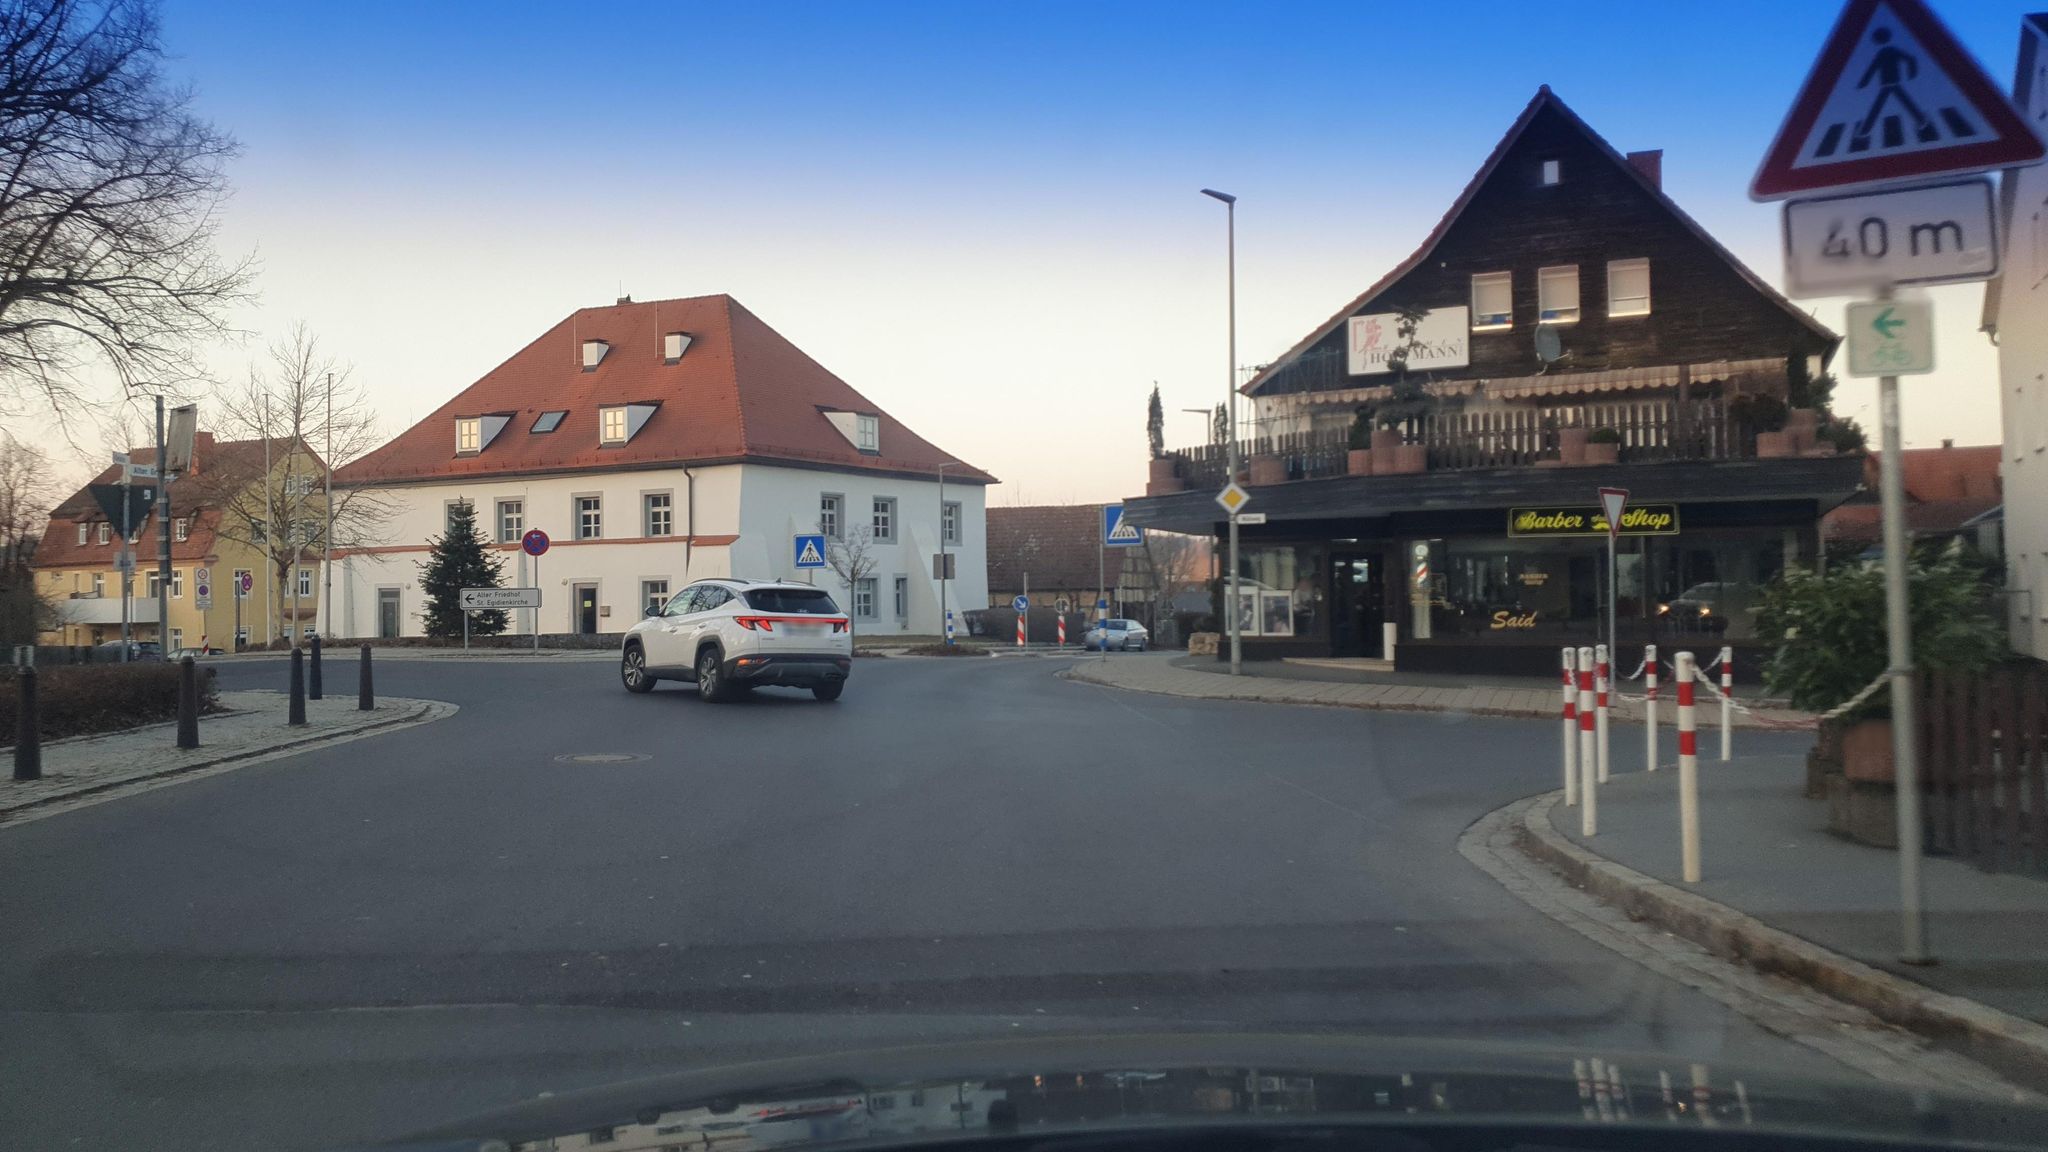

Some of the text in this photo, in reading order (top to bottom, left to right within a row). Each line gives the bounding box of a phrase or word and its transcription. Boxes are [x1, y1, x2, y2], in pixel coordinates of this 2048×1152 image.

[1822, 216, 1964, 259] 40 m
[1514, 508, 1671, 531] Barber Shop
[1490, 610, 1538, 630] Said
